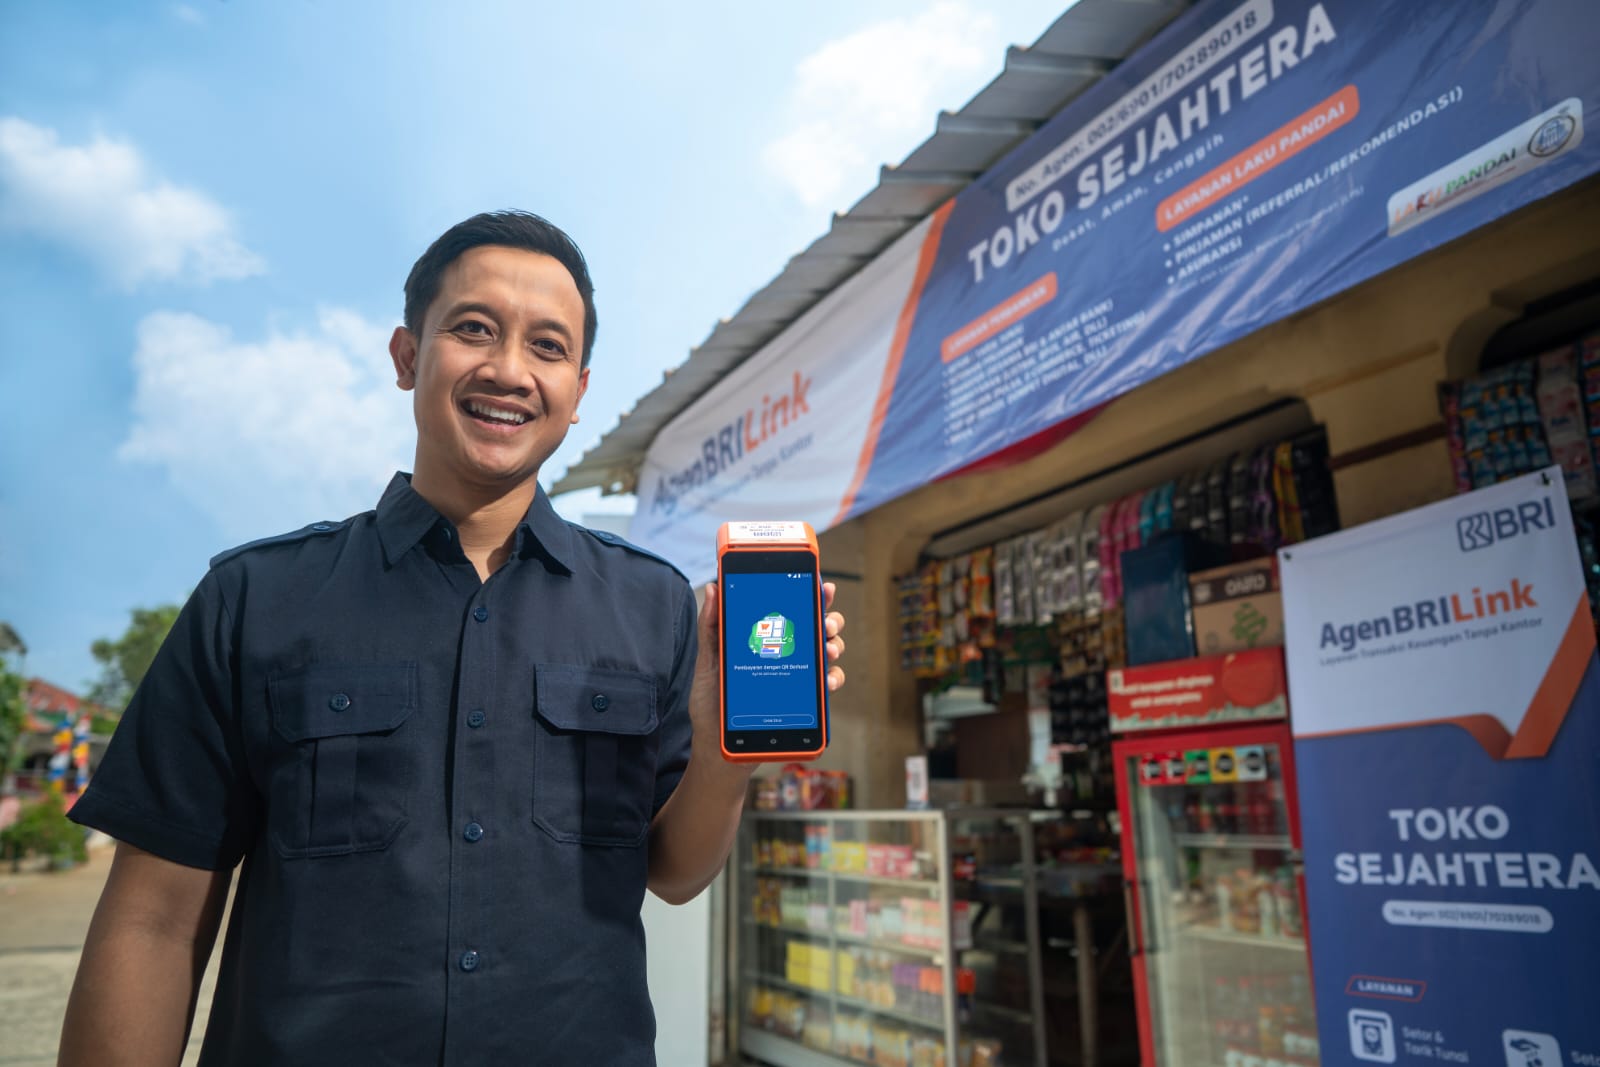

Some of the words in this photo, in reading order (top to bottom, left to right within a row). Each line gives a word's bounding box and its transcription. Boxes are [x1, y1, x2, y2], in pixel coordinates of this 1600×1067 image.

[967, 189, 1066, 284] TOKO
[1076, 2, 1337, 211] SEJAHTERA
[1154, 133, 1224, 185] Canggih
[1164, 173, 1233, 220] LAYANAN
[1234, 145, 1277, 179] LAKU
[1278, 101, 1346, 152] PANDAI
[1444, 148, 1518, 194] PANDAI
[651, 370, 813, 517] AgenBRILink
[1493, 495, 1556, 541] BRI
[1319, 577, 1539, 652] AgenBRILink
[1464, 625, 1500, 642] Tanpa
[1500, 616, 1544, 633] Kantor
[1388, 804, 1510, 841] TOKO
[1333, 852, 1600, 890] SEJAHTERA
[1357, 980, 1414, 996] LAYANAN
